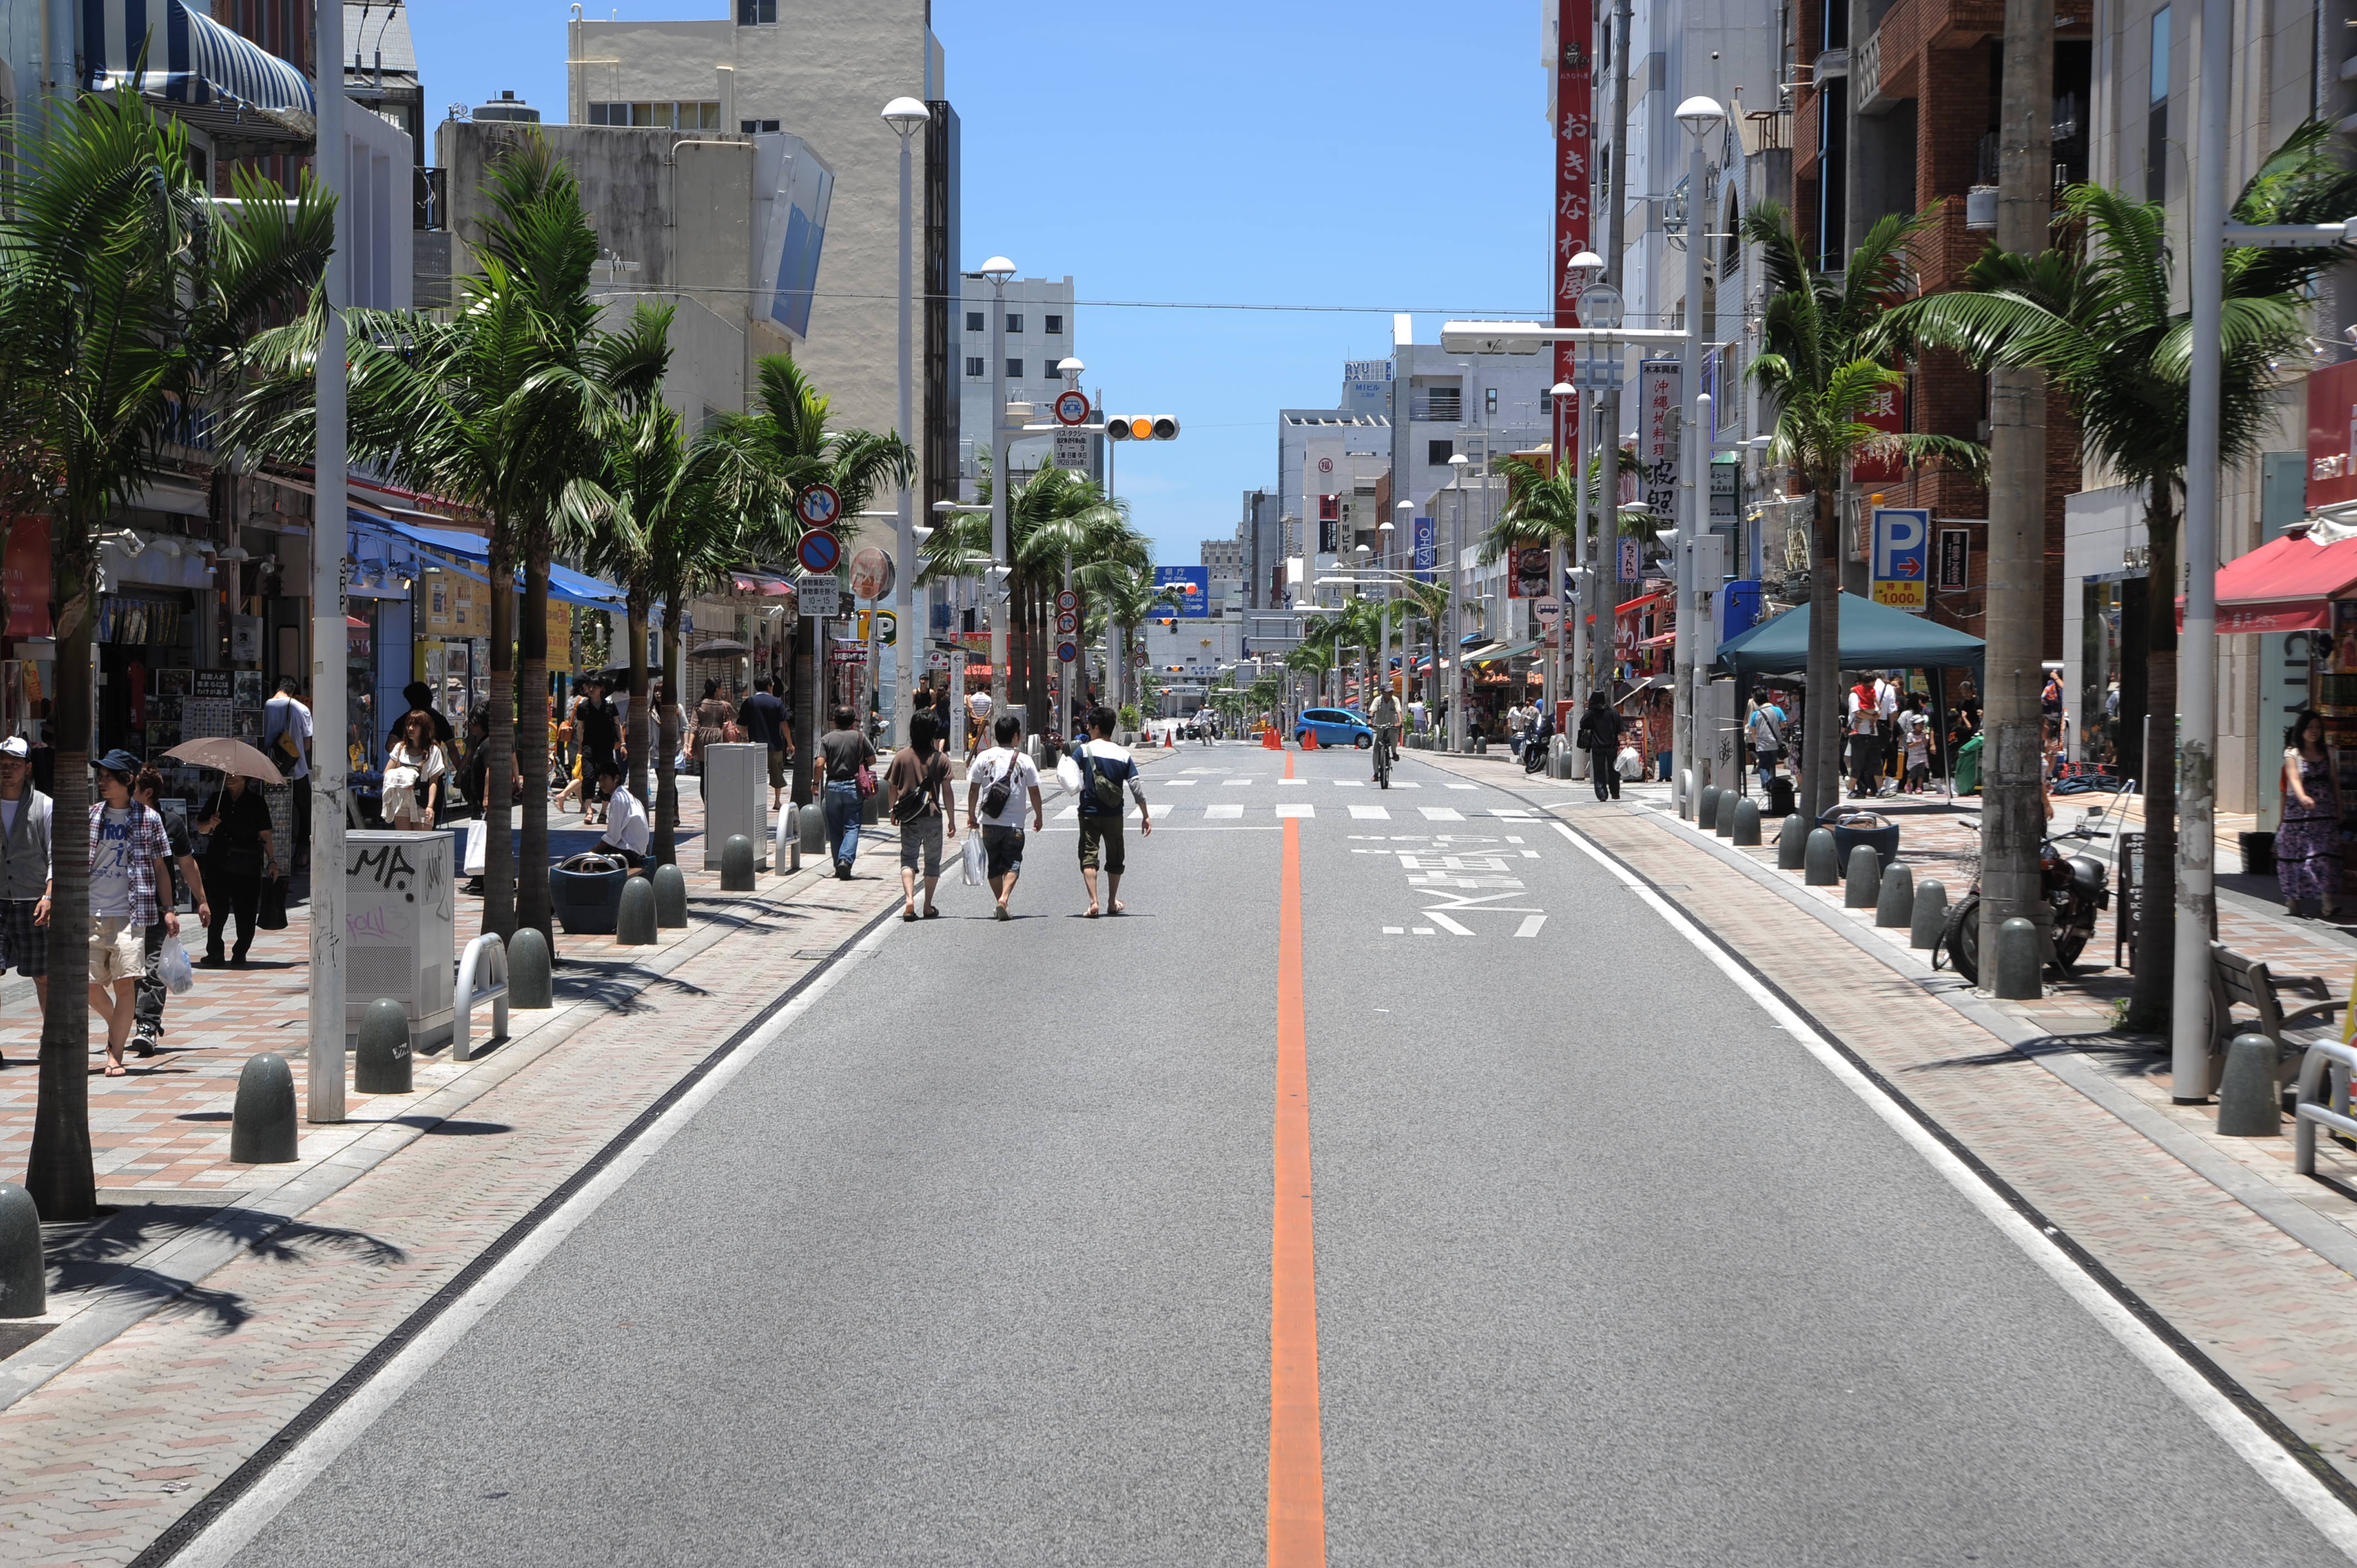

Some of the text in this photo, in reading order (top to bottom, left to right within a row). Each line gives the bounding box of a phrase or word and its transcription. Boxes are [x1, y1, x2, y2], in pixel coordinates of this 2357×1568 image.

[1558, 112, 1588, 300] おきなわ屋
[1644, 365, 1679, 374] 木本興産
[1653, 379, 1670, 456] 沖縄地料理
[1419, 528, 1430, 565] KAIHO
[1879, 514, 1923, 576] P
[1062, 597, 1073, 606] 30
